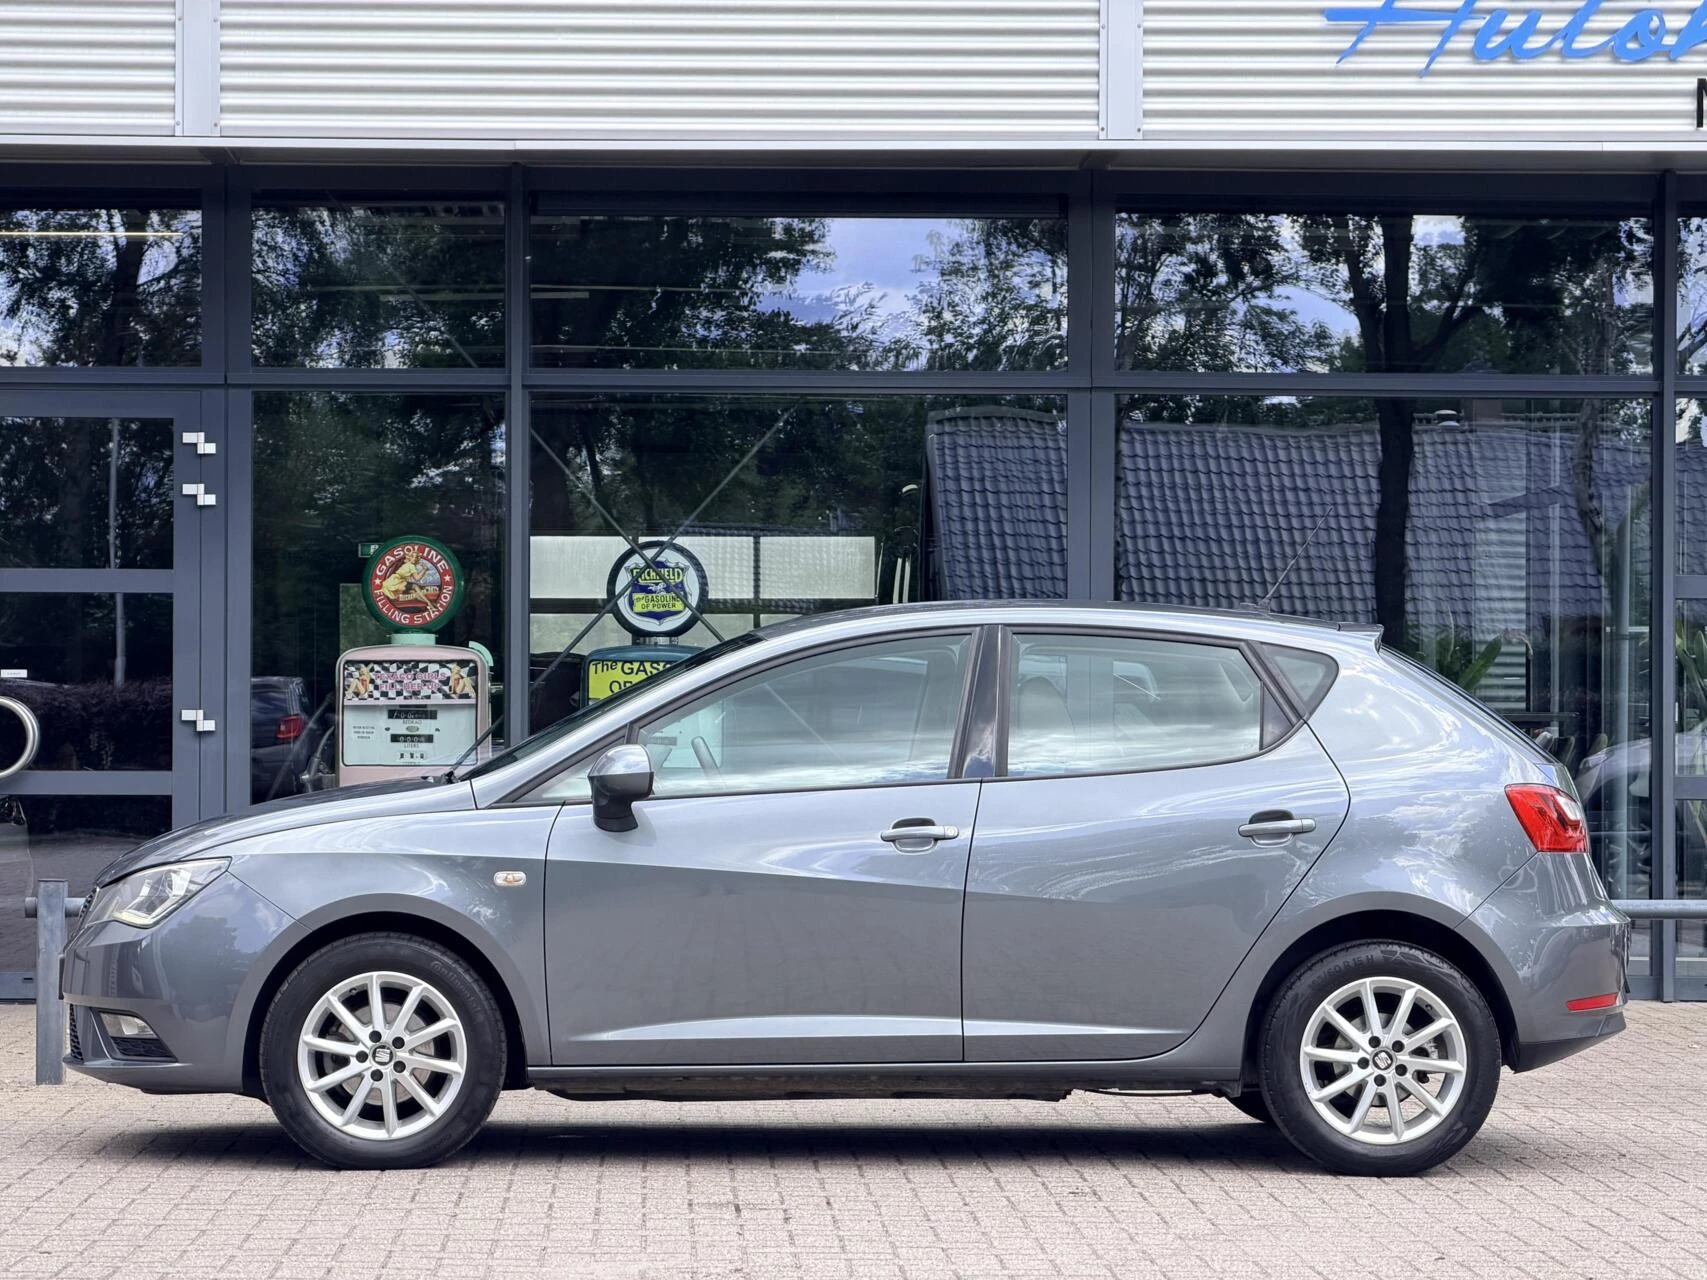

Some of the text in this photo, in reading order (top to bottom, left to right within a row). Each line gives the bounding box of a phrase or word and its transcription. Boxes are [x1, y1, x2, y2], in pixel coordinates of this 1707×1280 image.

[376, 545, 449, 576] GASOLINE
[374, 585, 453, 624] FILLING STATION
[592, 660, 617, 674] The
